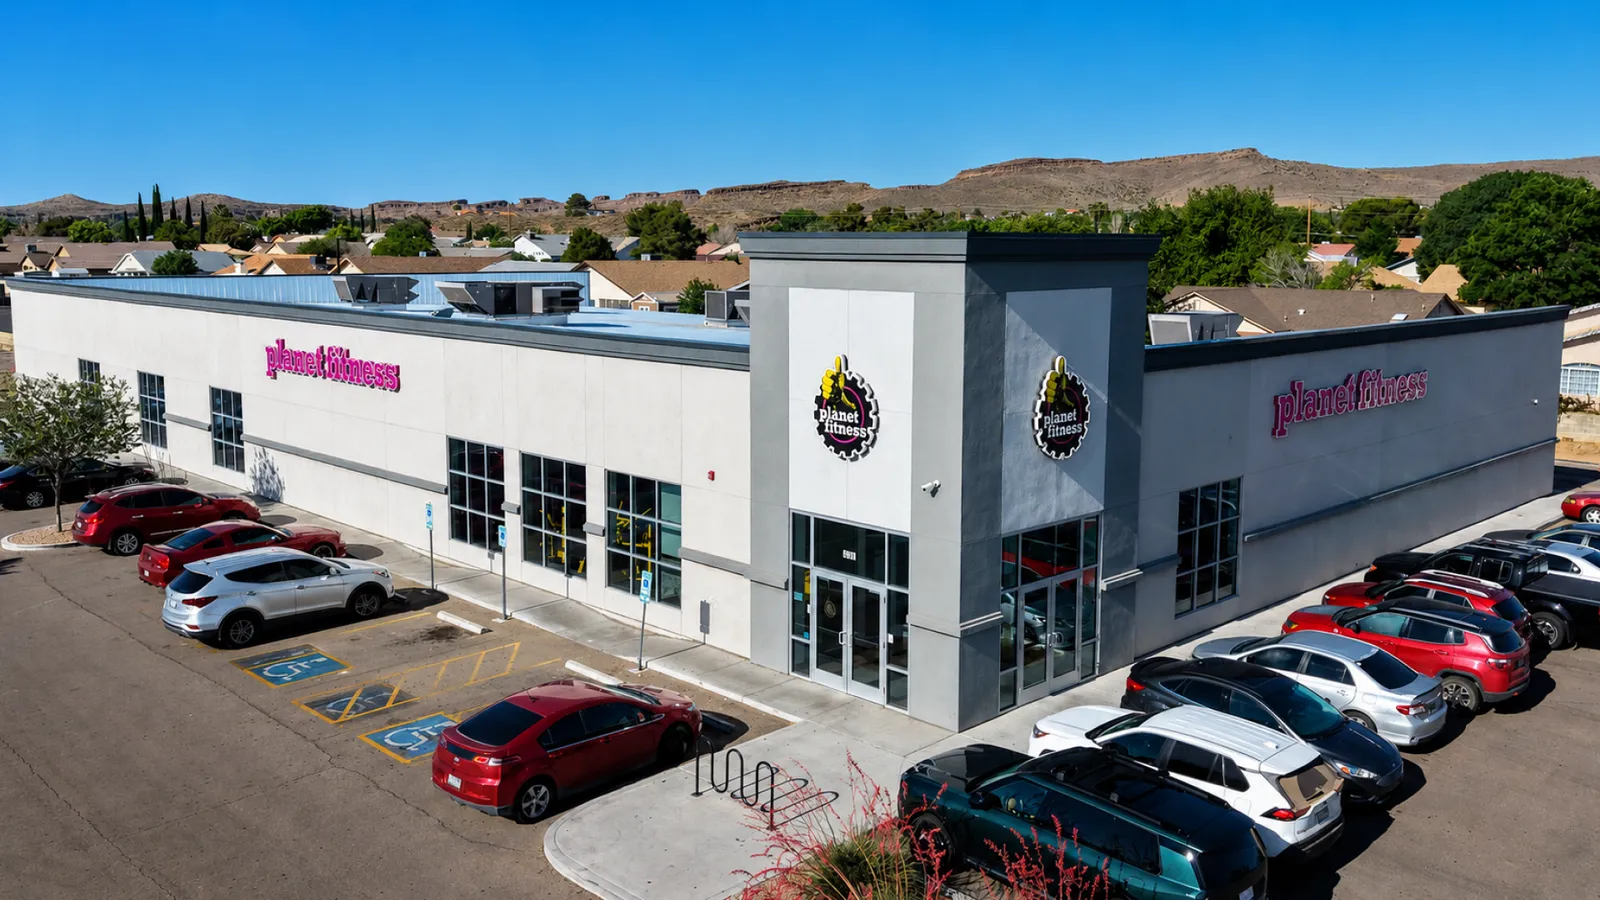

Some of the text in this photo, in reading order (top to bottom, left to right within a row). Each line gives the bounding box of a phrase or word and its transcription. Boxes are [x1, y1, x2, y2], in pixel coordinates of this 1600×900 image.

[265, 338, 399, 391] planet fitness
[1273, 369, 1428, 438] planet fitness
[819, 406, 859, 423] planet
[1043, 408, 1077, 428] planet
[824, 418, 867, 438] fitness
[1047, 422, 1082, 438] fitness
